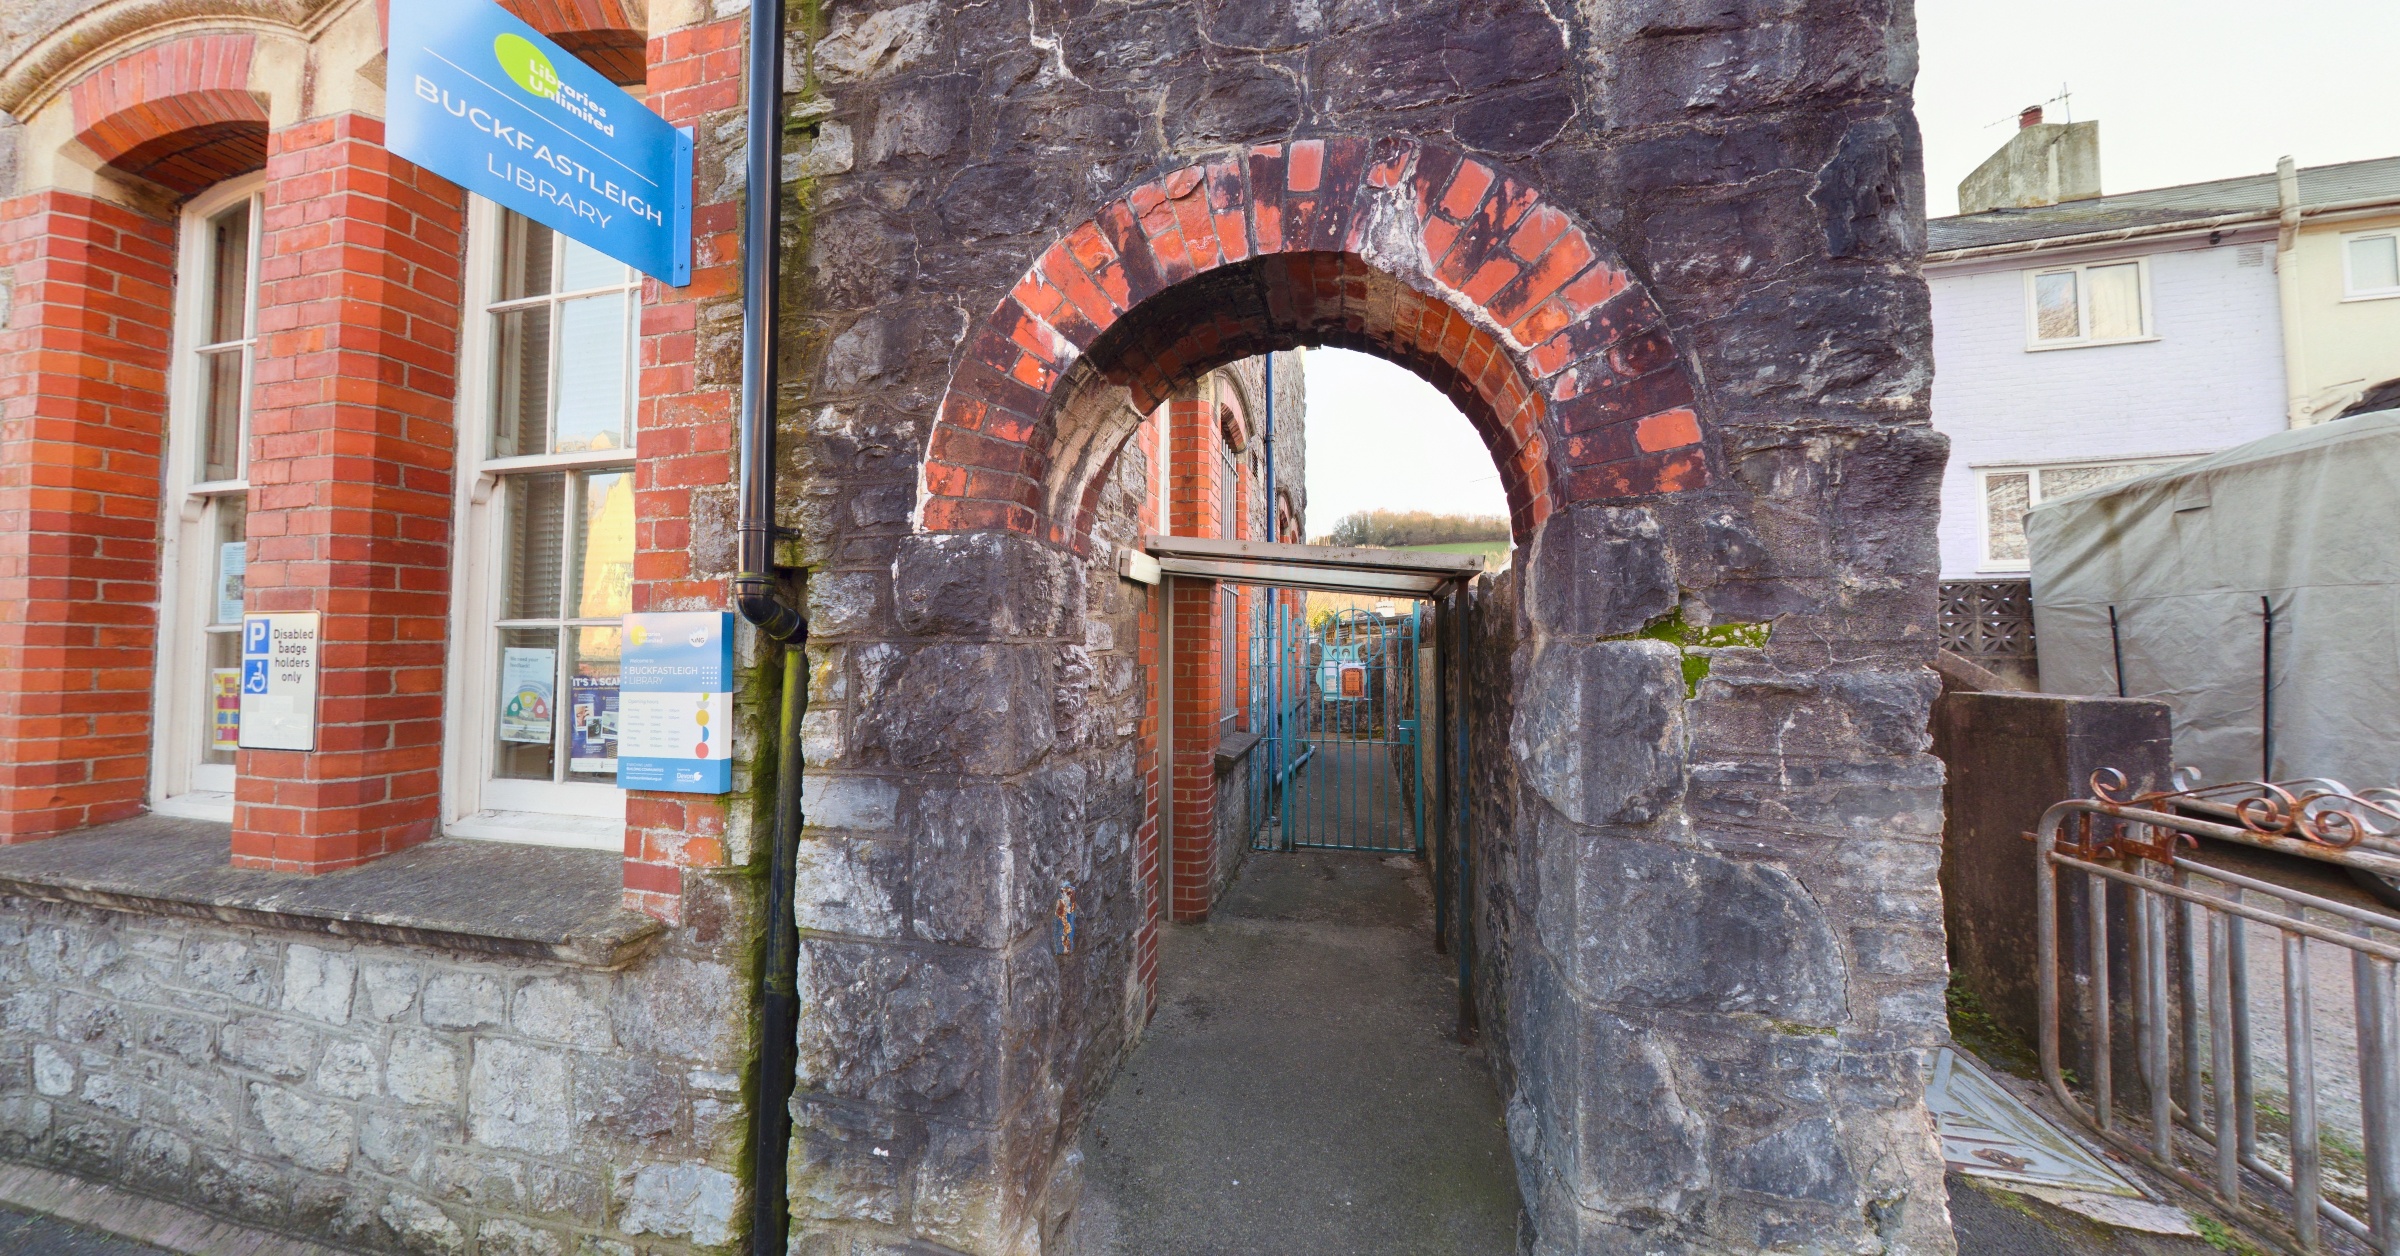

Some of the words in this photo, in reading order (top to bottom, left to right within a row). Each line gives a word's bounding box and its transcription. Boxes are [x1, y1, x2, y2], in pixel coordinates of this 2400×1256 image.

[529, 59, 607, 118] Libraries
[529, 75, 614, 138] Unlimited
[415, 74, 662, 227] BUCKFASTLEIGH
[488, 152, 612, 229] LIBRARY
[249, 622, 266, 651] P
[273, 629, 314, 640] Disabled
[278, 643, 307, 656] badge
[274, 658, 310, 668] holders
[629, 666, 698, 675] BUCKFASTLEIGH
[281, 671, 302, 684] only
[572, 678, 588, 686] IT'S
[591, 677, 598, 686] A
[629, 676, 664, 685] LIBRARY
